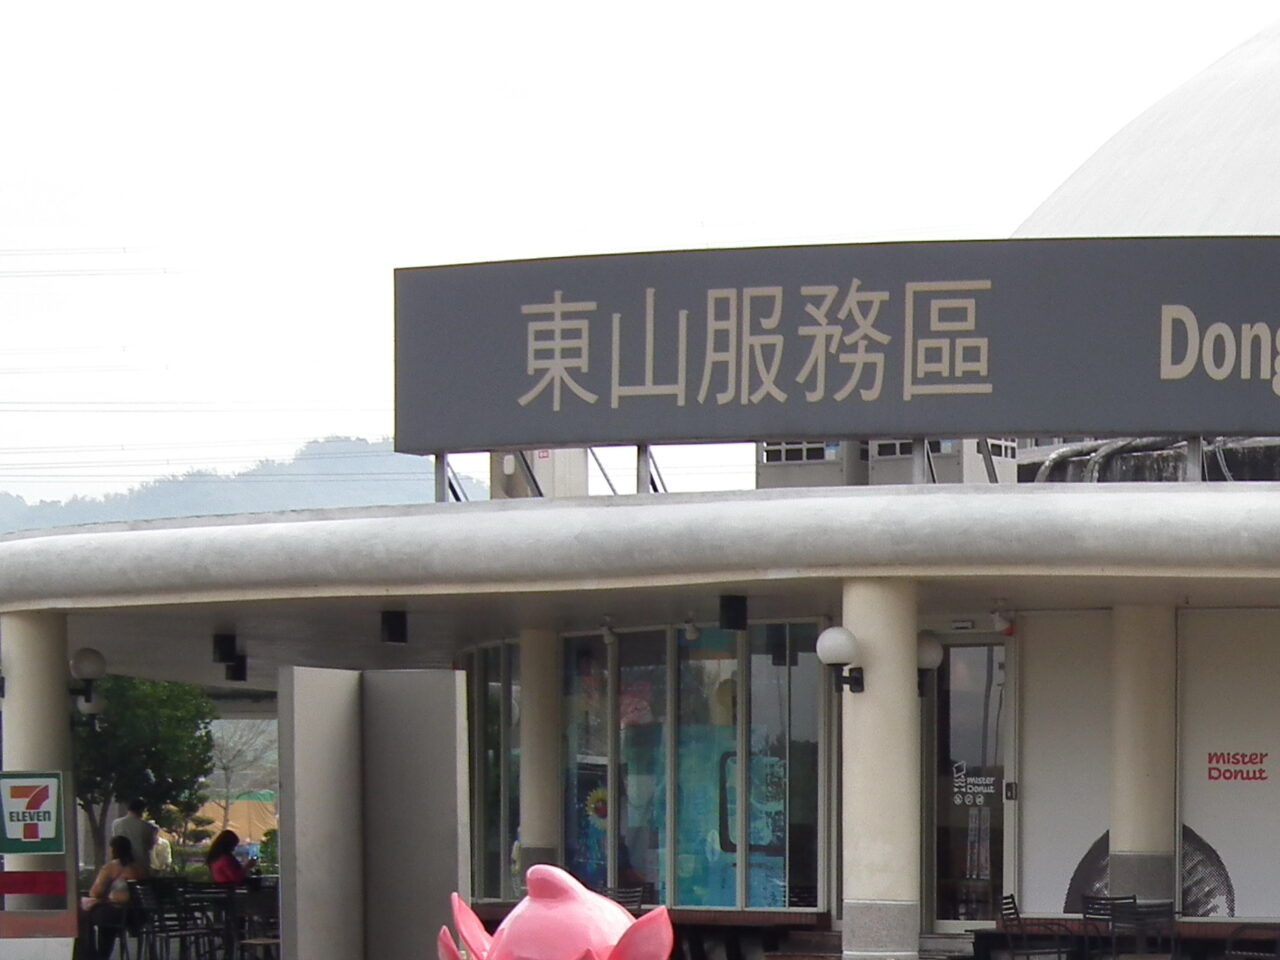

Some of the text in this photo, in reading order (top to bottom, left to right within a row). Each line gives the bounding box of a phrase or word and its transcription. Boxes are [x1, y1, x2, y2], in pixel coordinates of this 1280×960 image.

[516, 278, 993, 412] 東山服務區
[1207, 768, 1268, 781] Donut
